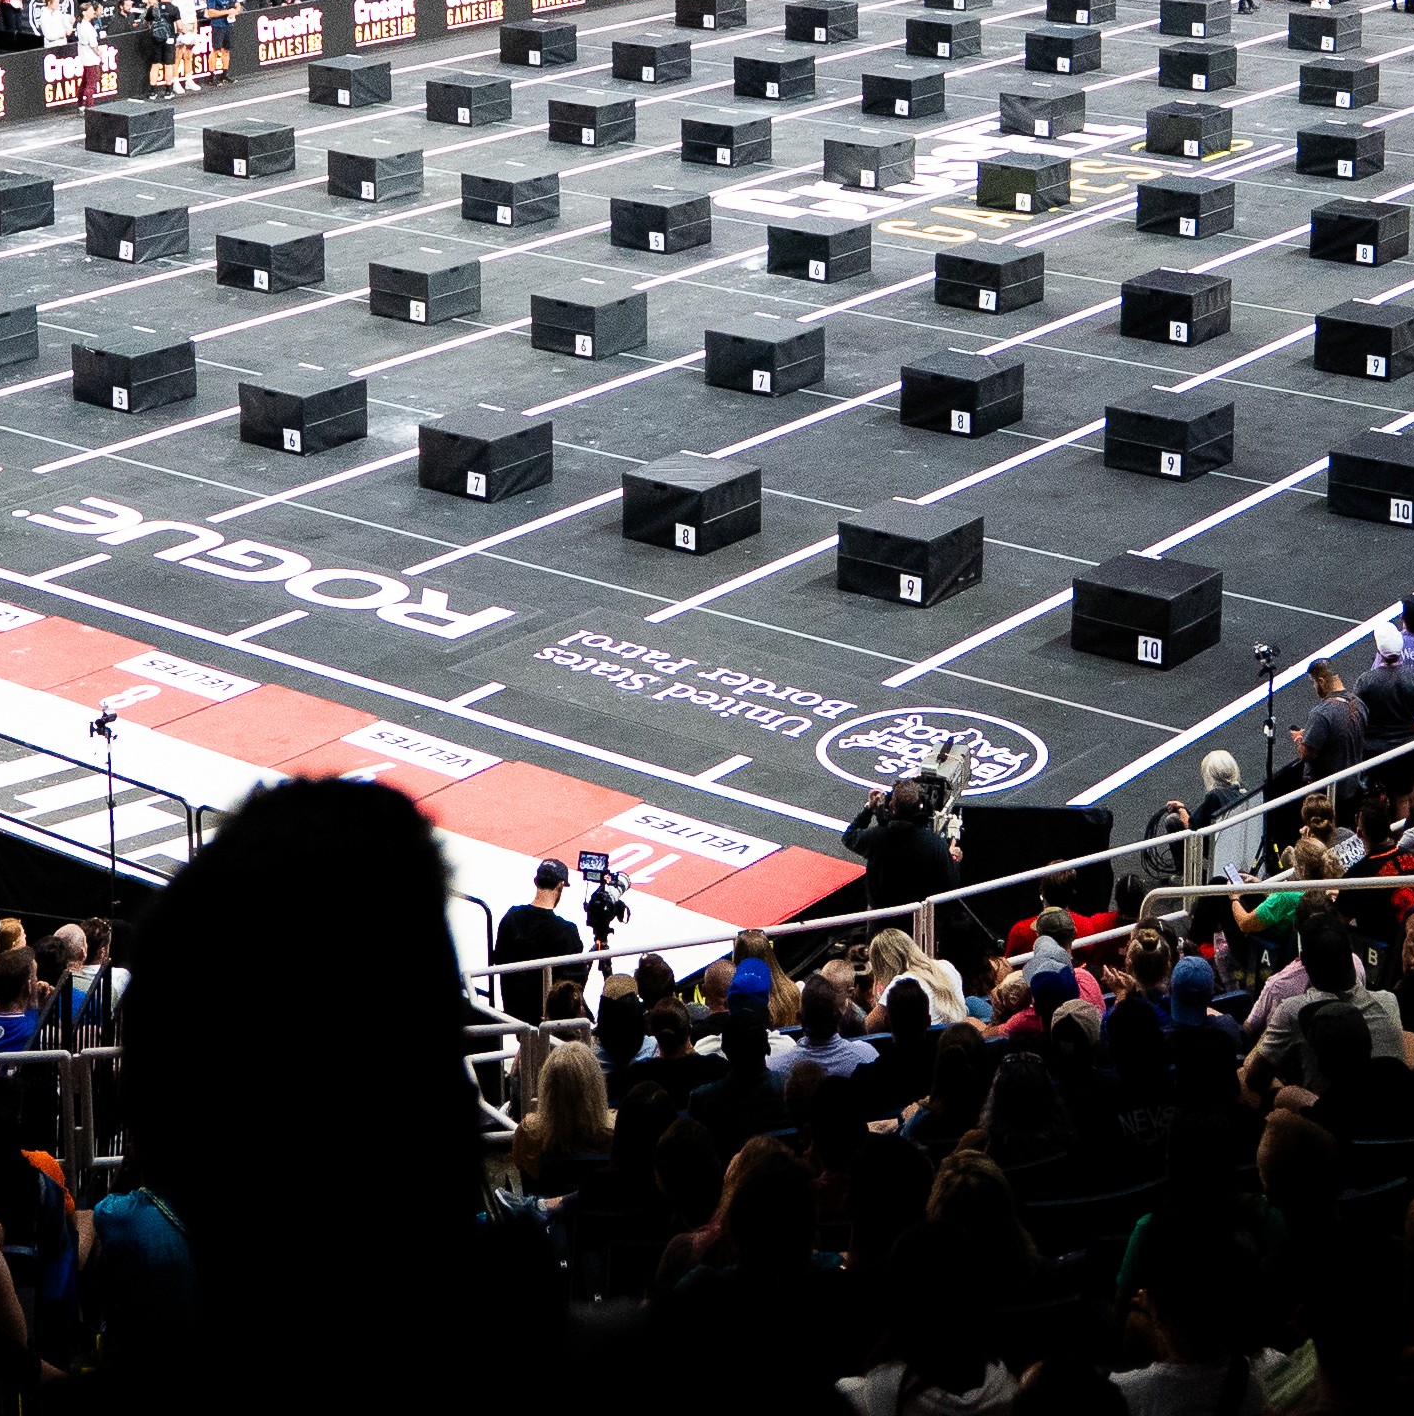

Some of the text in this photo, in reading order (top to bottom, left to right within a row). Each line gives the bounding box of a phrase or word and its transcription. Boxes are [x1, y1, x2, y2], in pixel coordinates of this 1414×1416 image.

[1175, 324, 1182, 340] 8
[1373, 358, 1380, 375] 9
[758, 374, 765, 390] 7
[118, 390, 124, 407] 5
[957, 413, 964, 431] 8
[289, 432, 296, 449] 6
[1167, 455, 1175, 473] 9
[474, 475, 481, 493] 7
[1394, 502, 1410, 522] 10
[681, 528, 690, 547] 8
[25, 497, 517, 640] ROGUE
[906, 579, 915, 598] 9
[1142, 639, 1159, 661] 10
[564, 629, 858, 721] Border Patrol
[534, 646, 813, 739] United States
[634, 813, 749, 856] VELITES
